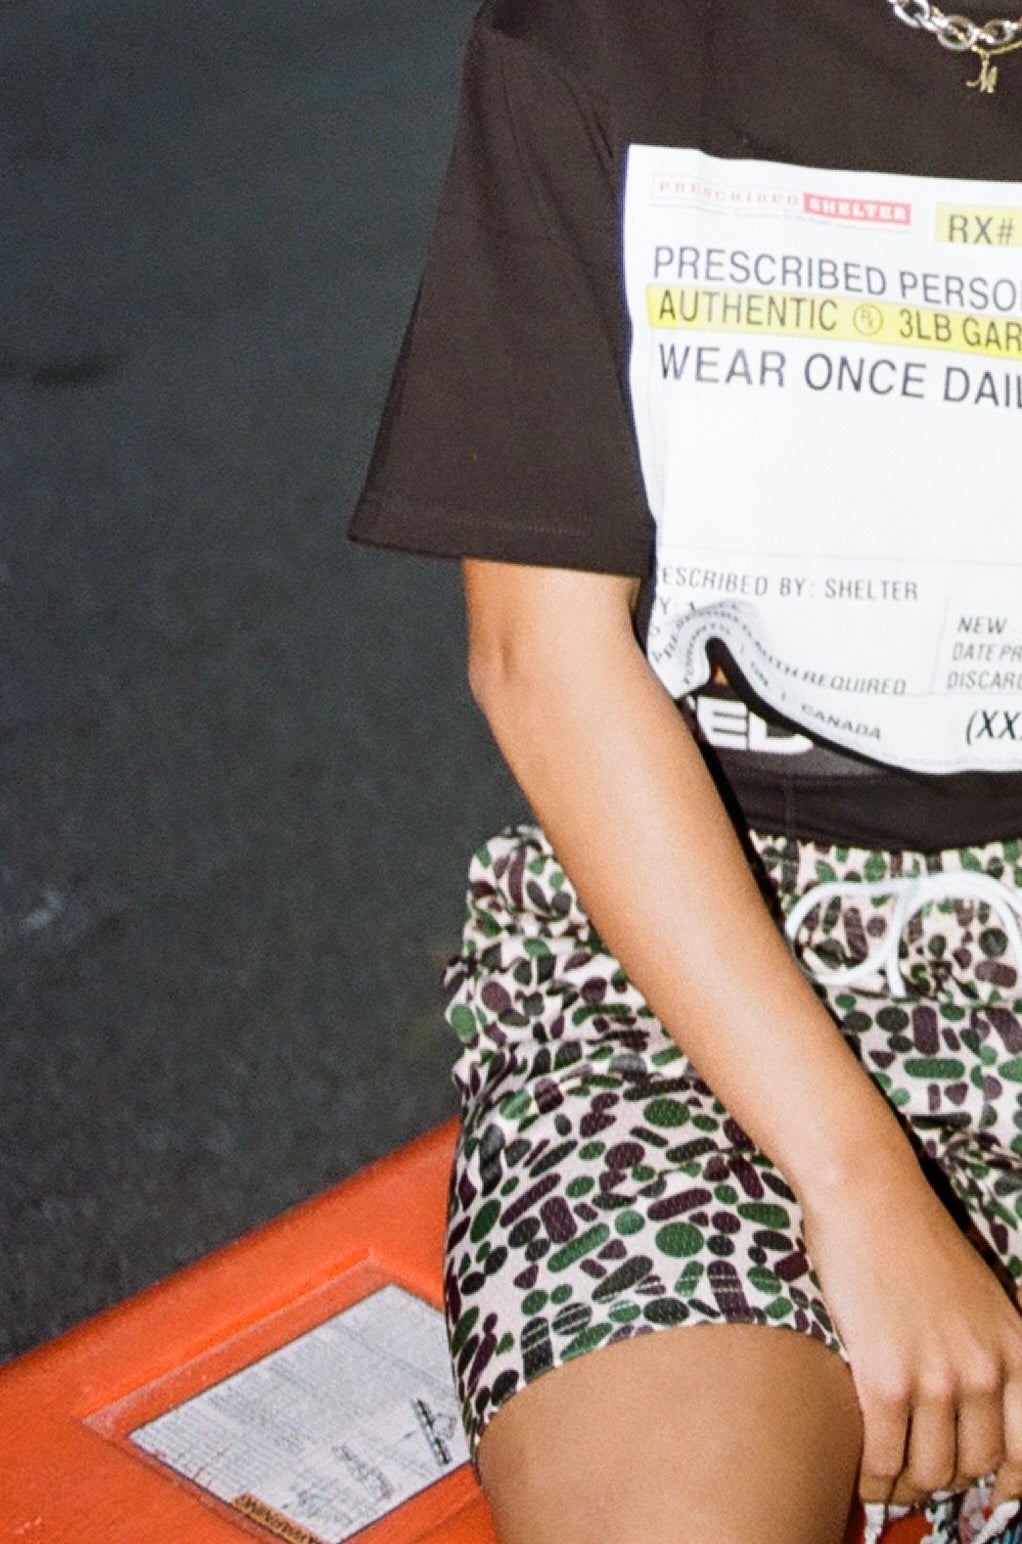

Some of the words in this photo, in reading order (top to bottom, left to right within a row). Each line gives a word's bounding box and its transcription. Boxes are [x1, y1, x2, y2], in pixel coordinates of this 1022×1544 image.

[658, 180, 799, 207] PRESCRIBED
[807, 195, 909, 223] SHELTER
[947, 213, 1014, 245] RX#
[653, 244, 887, 297] PRESCRIBED
[658, 288, 839, 332] AUTHENTIC
[899, 308, 952, 343] 3LB
[658, 342, 787, 389] WEAR
[803, 352, 928, 399] ONCE
[661, 564, 768, 597] ESCRIBED
[824, 577, 918, 601] SHELTER
[956, 615, 1008, 635] NEW
[952, 641, 995, 662] DATE
[802, 670, 907, 696] REQUIRED
[800, 703, 882, 741] CANADA
